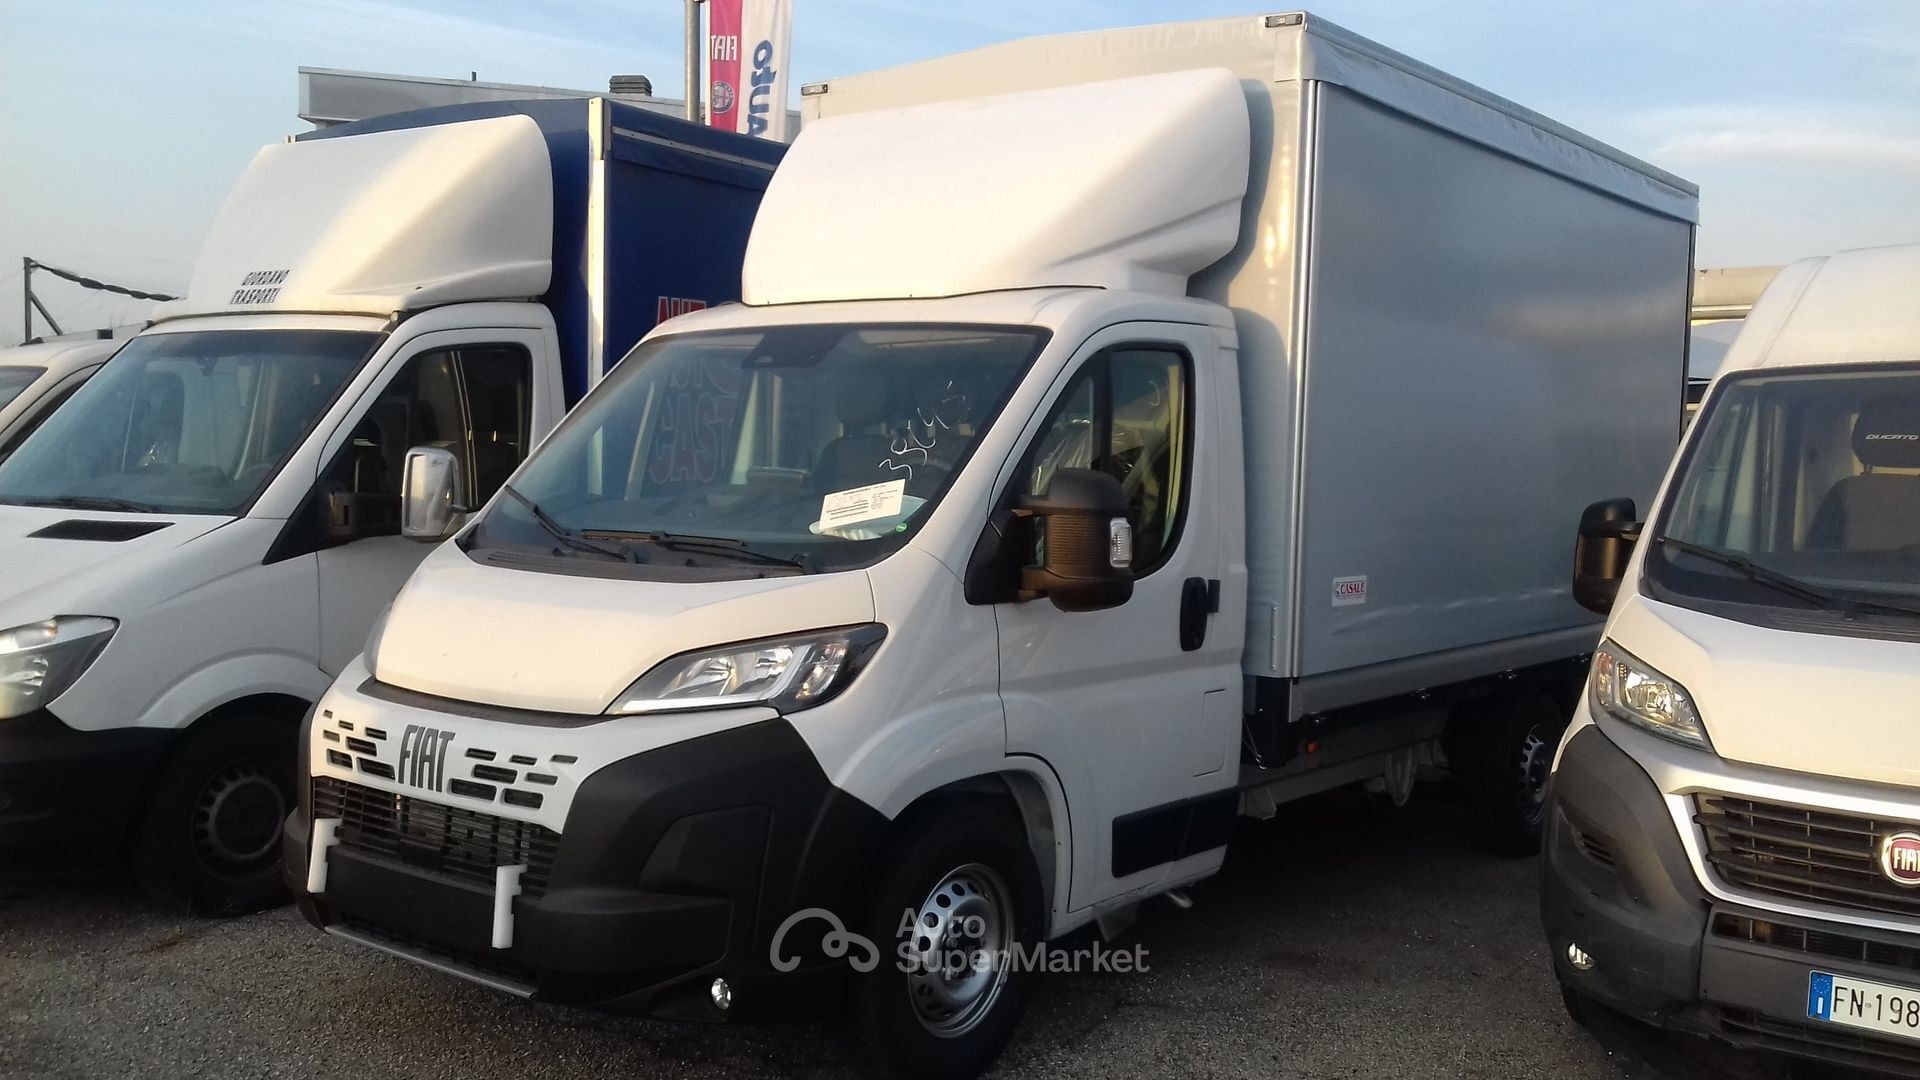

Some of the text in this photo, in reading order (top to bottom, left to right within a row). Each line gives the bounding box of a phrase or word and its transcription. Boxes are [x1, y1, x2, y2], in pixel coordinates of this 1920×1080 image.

[241, 270, 290, 286] GIORDANO
[230, 287, 281, 304] TRASPORTI
[1340, 582, 1366, 595] CASALE
[398, 724, 456, 793] FIAT
